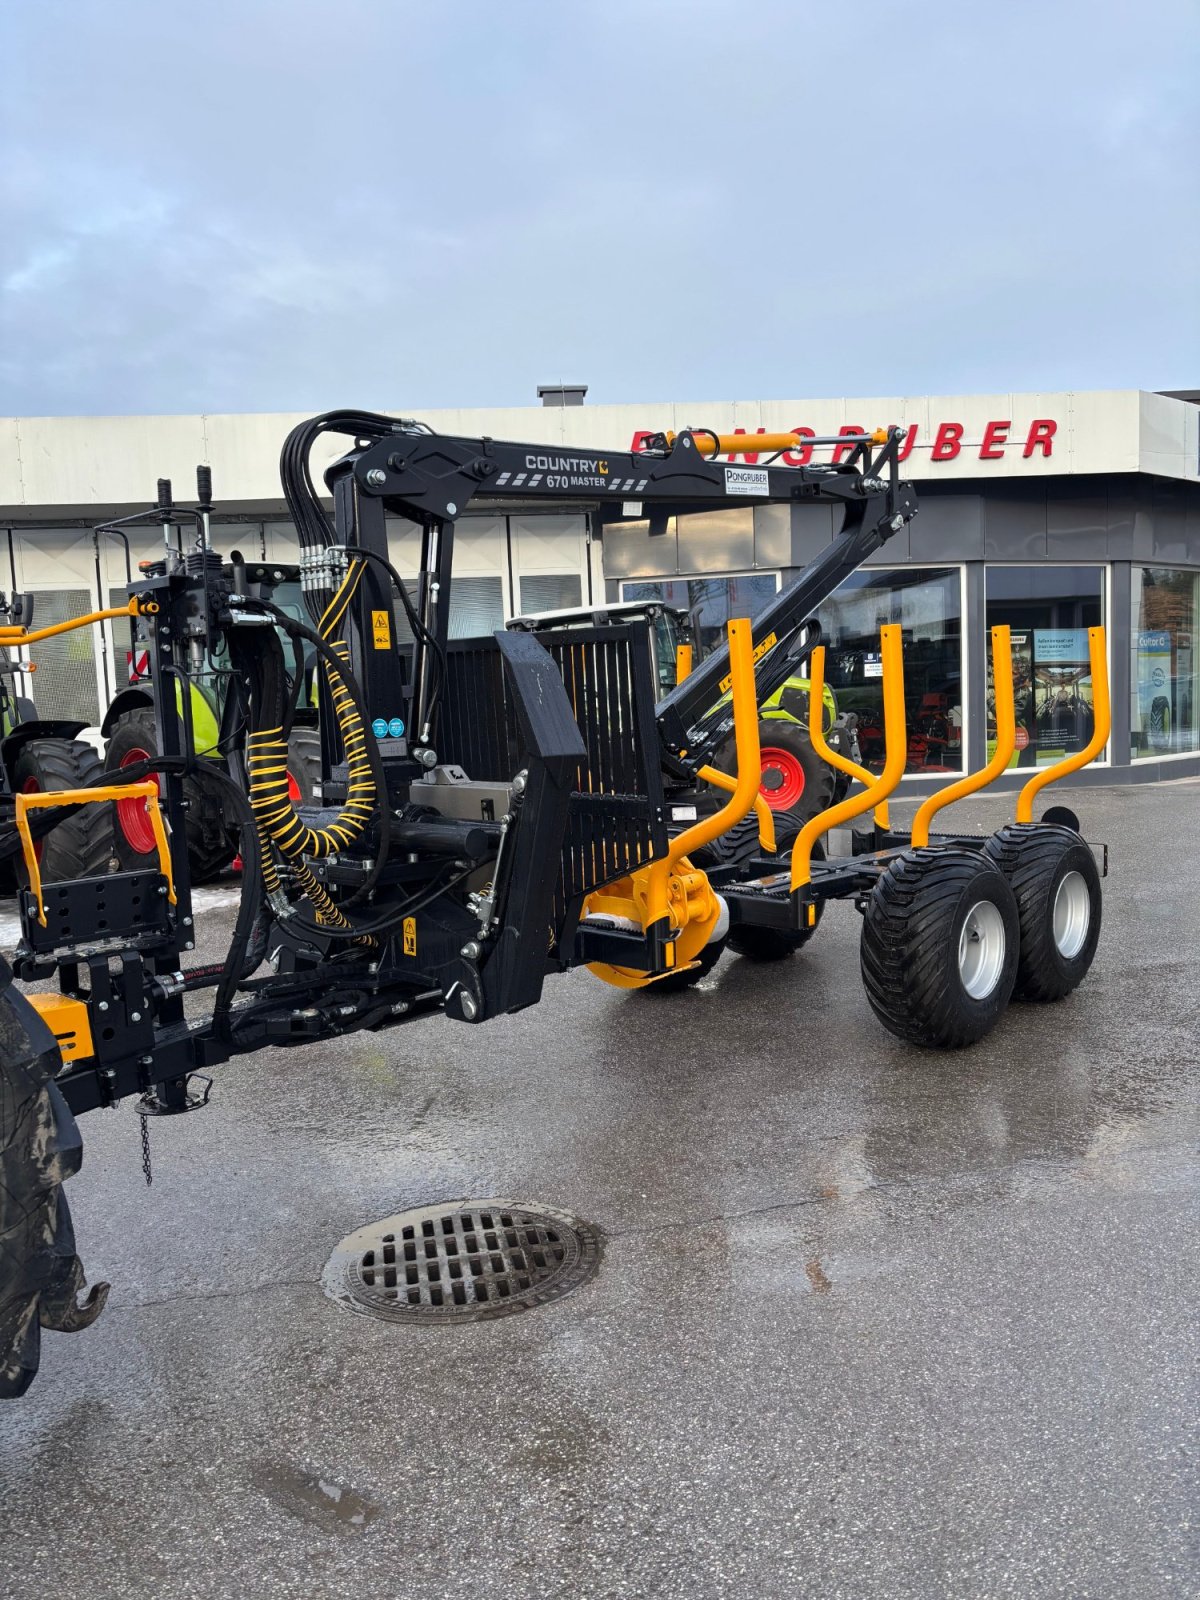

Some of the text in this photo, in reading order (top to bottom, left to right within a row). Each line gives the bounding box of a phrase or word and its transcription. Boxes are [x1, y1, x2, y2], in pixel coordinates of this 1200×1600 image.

[631, 419, 1058, 466] PGRUBER
[525, 455, 598, 473] COUNTRY
[546, 475, 606, 489] 670 MASTER
[726, 470, 767, 482] PONGRUBER
